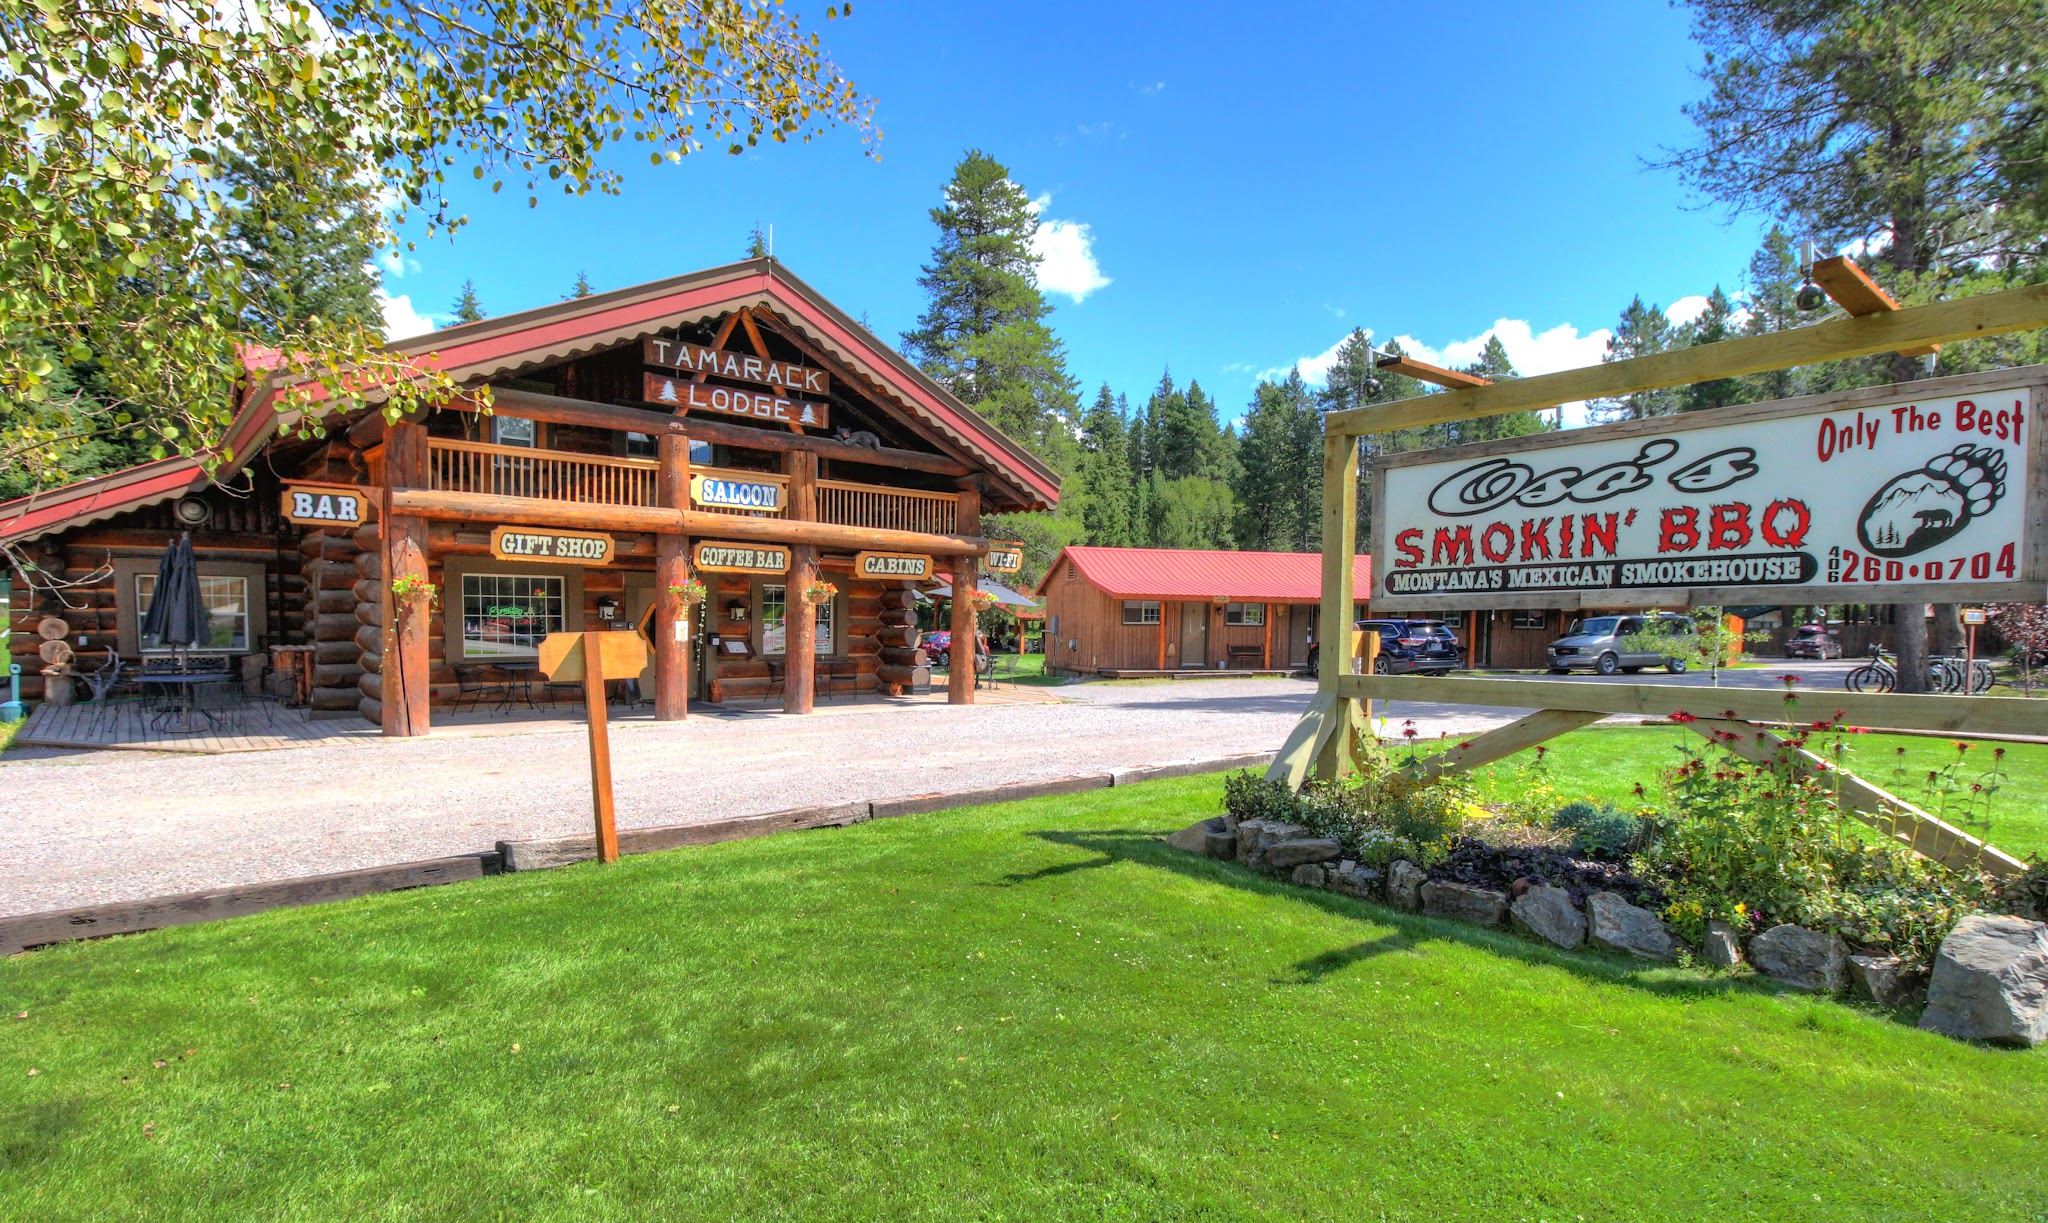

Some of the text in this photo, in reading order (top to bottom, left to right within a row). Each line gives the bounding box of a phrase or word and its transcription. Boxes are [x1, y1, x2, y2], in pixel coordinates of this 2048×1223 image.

[652, 339, 822, 392] TAMARACK
[688, 384, 791, 421] LODGE
[1817, 399, 2024, 463] Only The Best
[702, 479, 777, 507] SALOON
[1427, 438, 1760, 517] Oso's
[292, 492, 359, 522] BAR
[500, 533, 608, 559] GIFT SHOP
[1394, 496, 1812, 569] SMOKIN' BBQ
[700, 547, 786, 570] COFFEE BAR
[864, 556, 926, 576] CABINS
[1392, 556, 1802, 592] MONTANA'S MEXICAN SMOKEHOUSE
